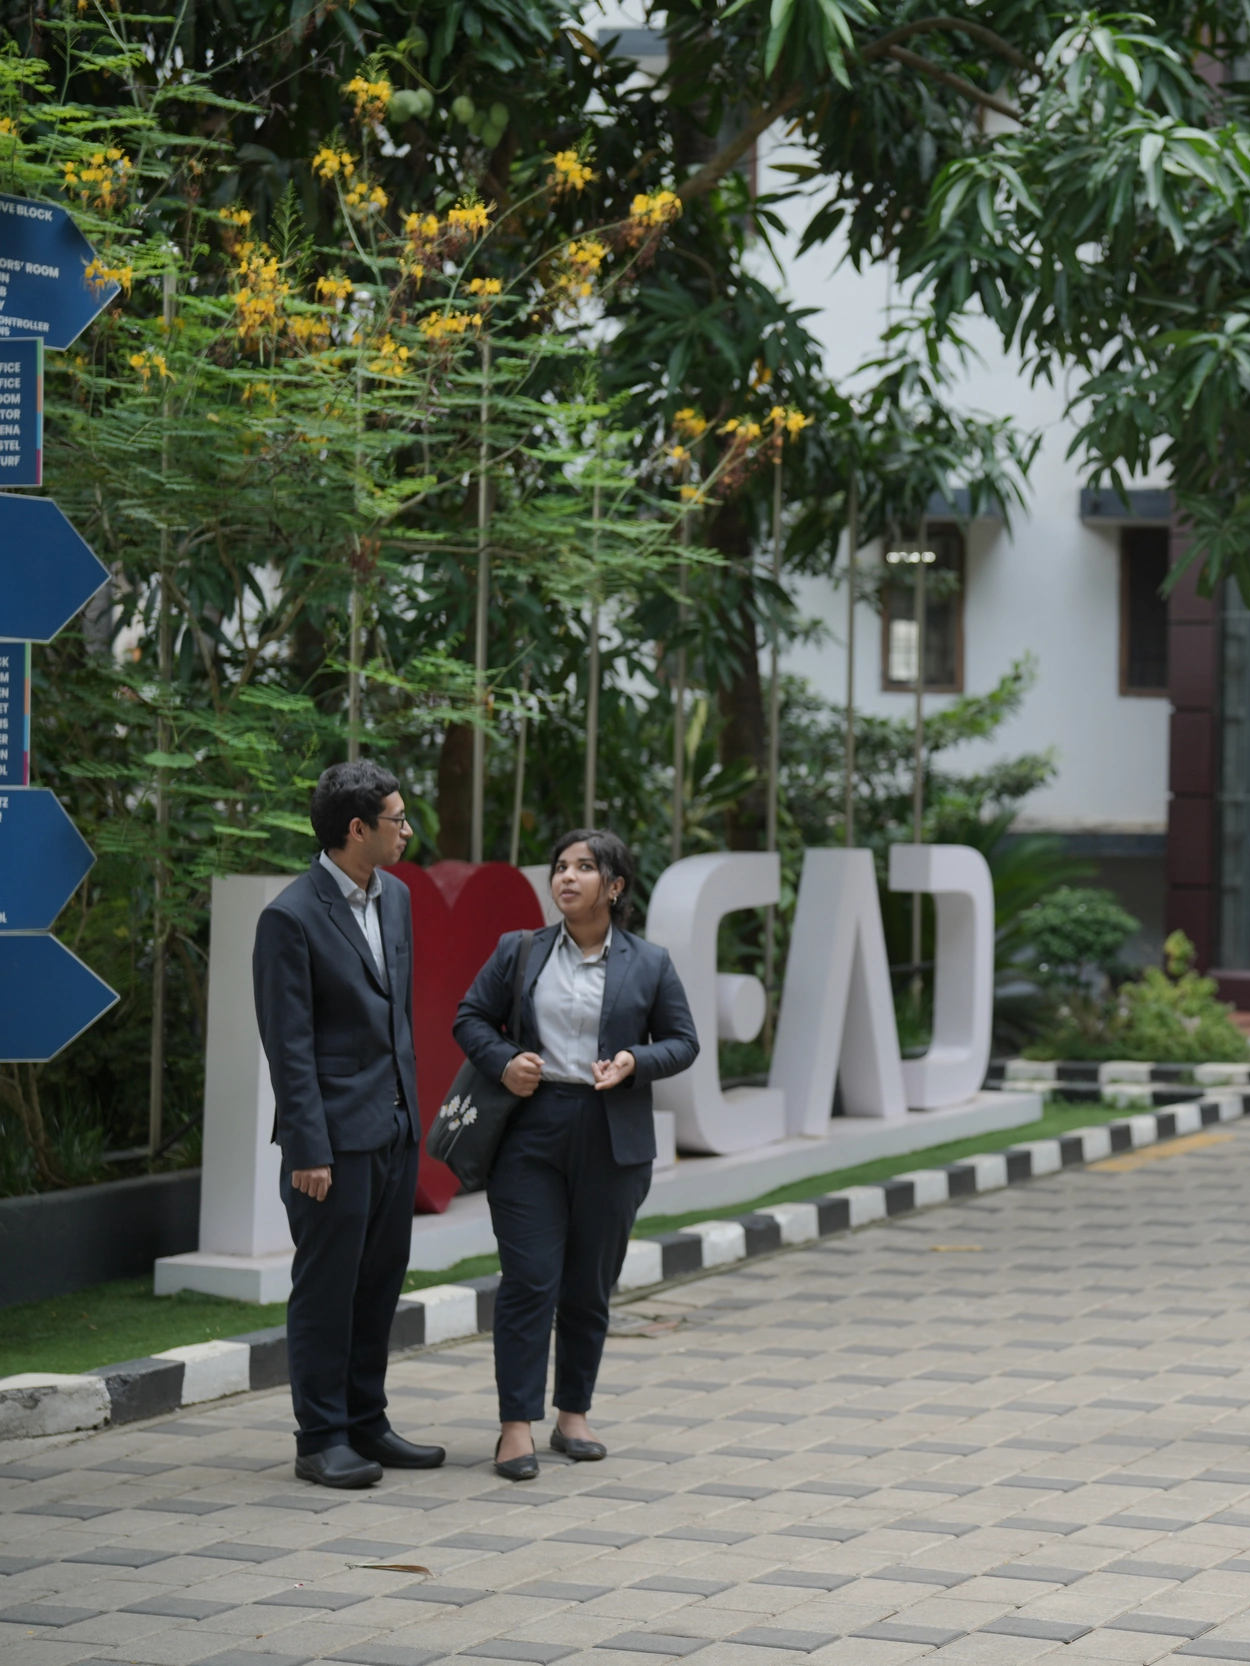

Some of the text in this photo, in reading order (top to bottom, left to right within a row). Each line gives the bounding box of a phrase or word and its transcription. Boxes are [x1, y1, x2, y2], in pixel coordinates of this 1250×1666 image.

[16, 204, 54, 222] BLOCK
[25, 261, 60, 279] ROOM
[0, 455, 21, 467] URF
[521, 843, 995, 1170] EAD
